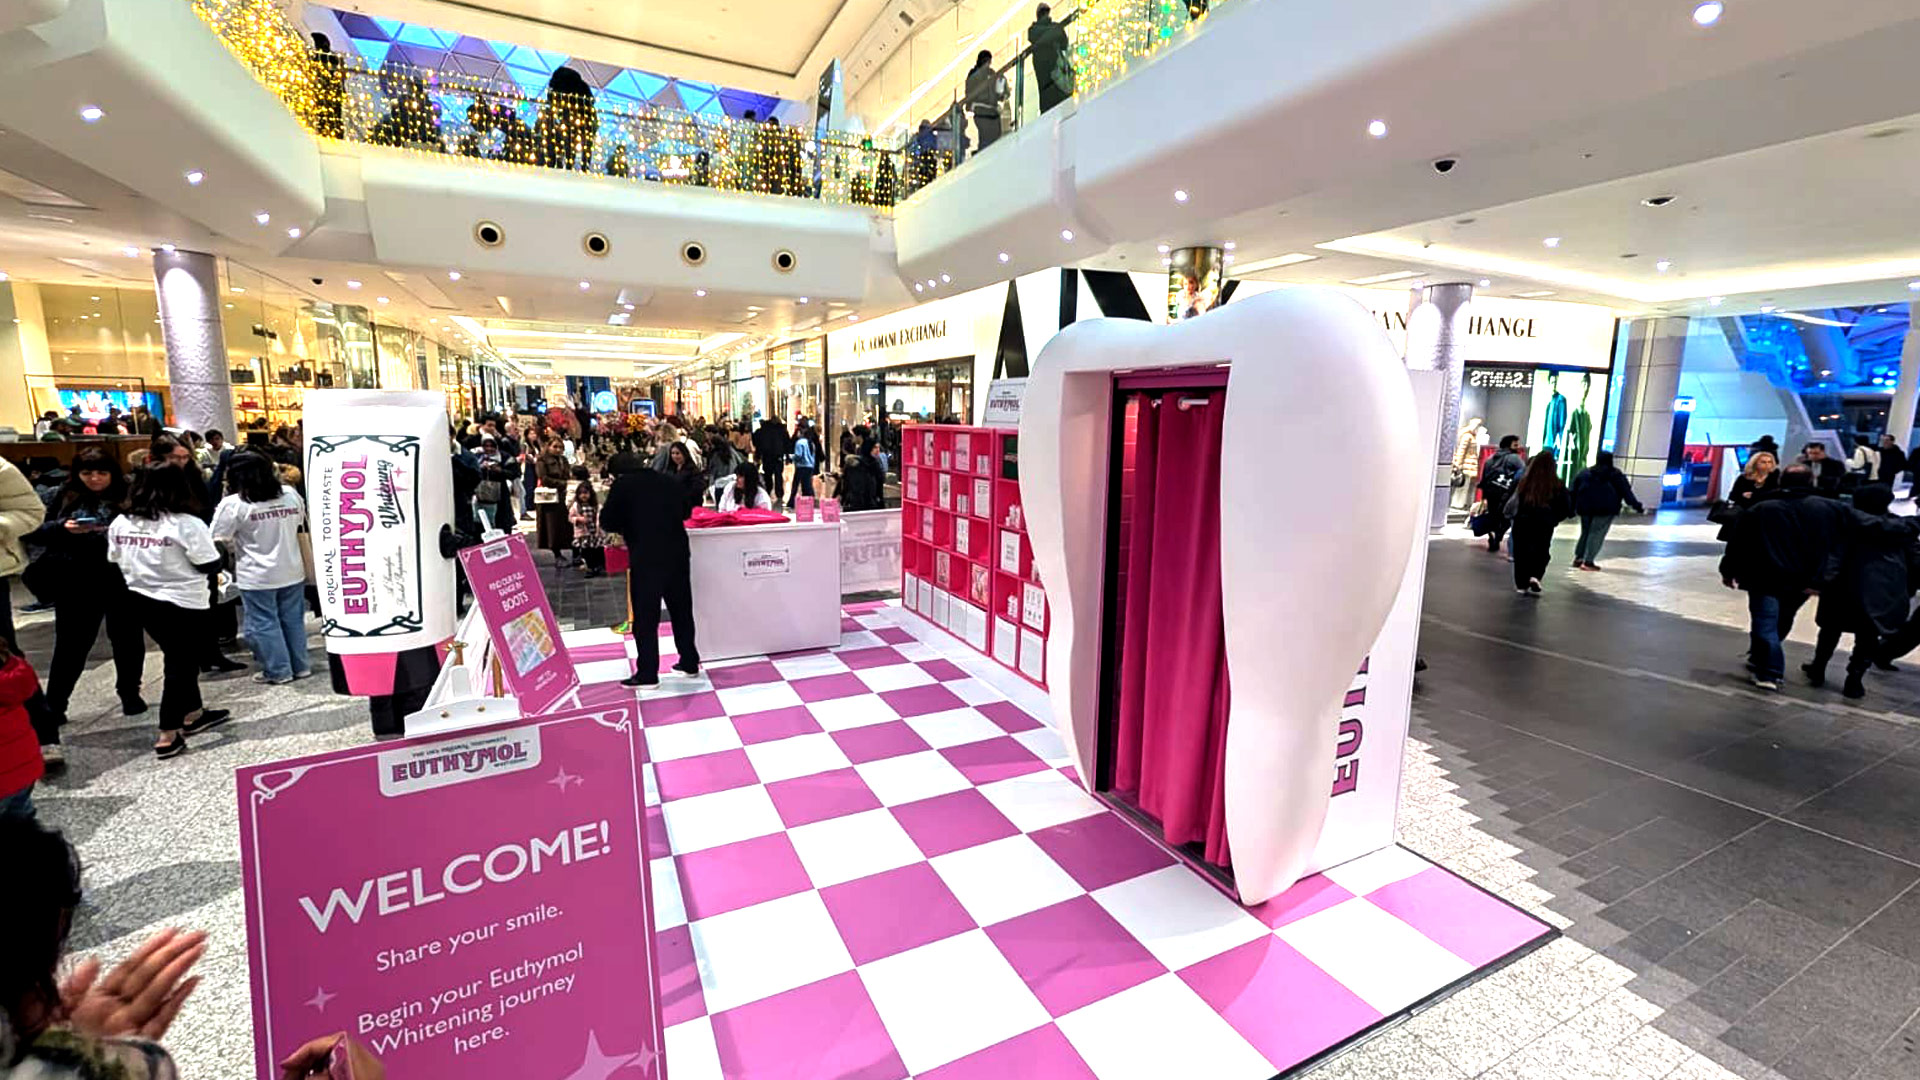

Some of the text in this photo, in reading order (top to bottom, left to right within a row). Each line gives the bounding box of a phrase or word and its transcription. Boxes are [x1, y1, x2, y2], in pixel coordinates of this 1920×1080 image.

[900, 320, 947, 345] EXCHANGE
[377, 459, 401, 529] Whitening
[322, 466, 339, 604] ORIGINAL TOOTHPASTE
[339, 454, 375, 615] EUTHYMOL
[501, 591, 529, 612] BOOTS
[391, 741, 528, 783] EUTHYMOL
[1330, 655, 1370, 798] EU
[298, 819, 612, 934] WELCOME!
[376, 902, 564, 972] Share your smile.
[357, 942, 585, 1035] Begin your Euthymol
[371, 972, 577, 1056] Whitening journey
[453, 1025, 511, 1055] here.
